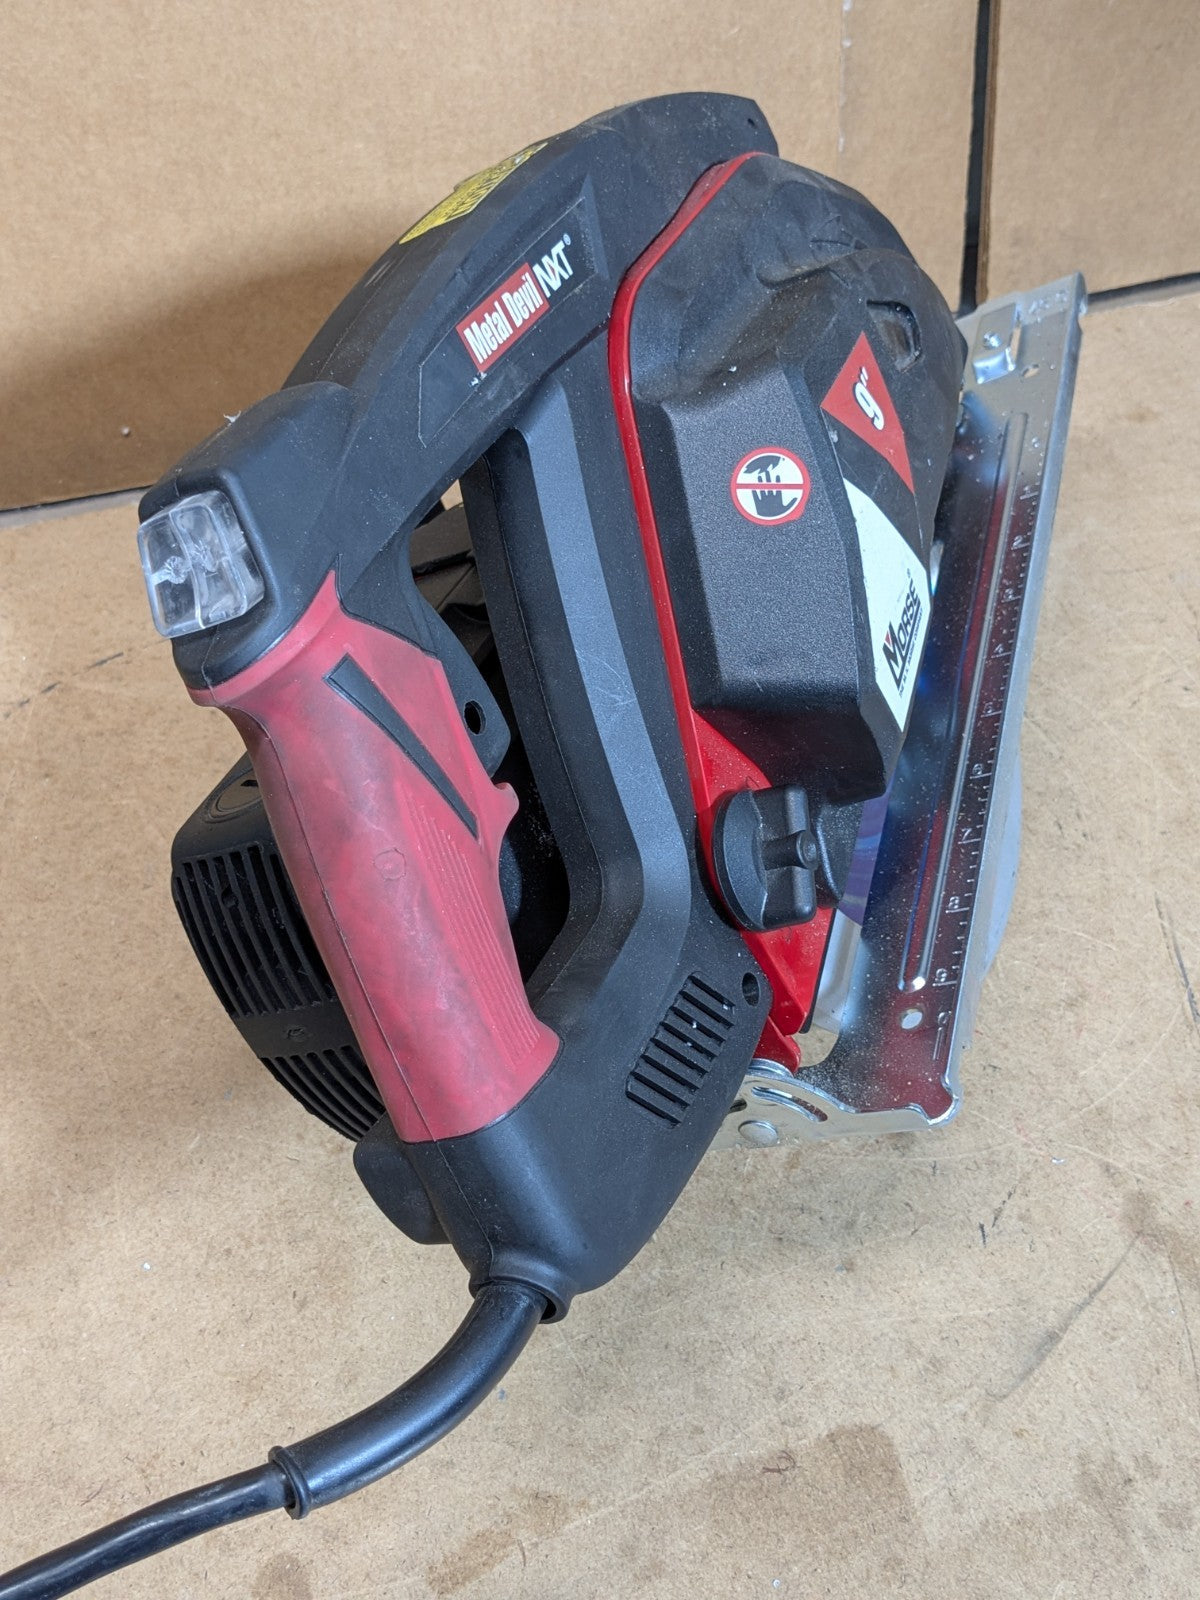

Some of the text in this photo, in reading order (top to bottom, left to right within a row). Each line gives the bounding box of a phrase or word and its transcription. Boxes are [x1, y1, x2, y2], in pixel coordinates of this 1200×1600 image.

[463, 300, 514, 364] Metal
[501, 271, 544, 328] Devil
[882, 578, 921, 692] MORSE
